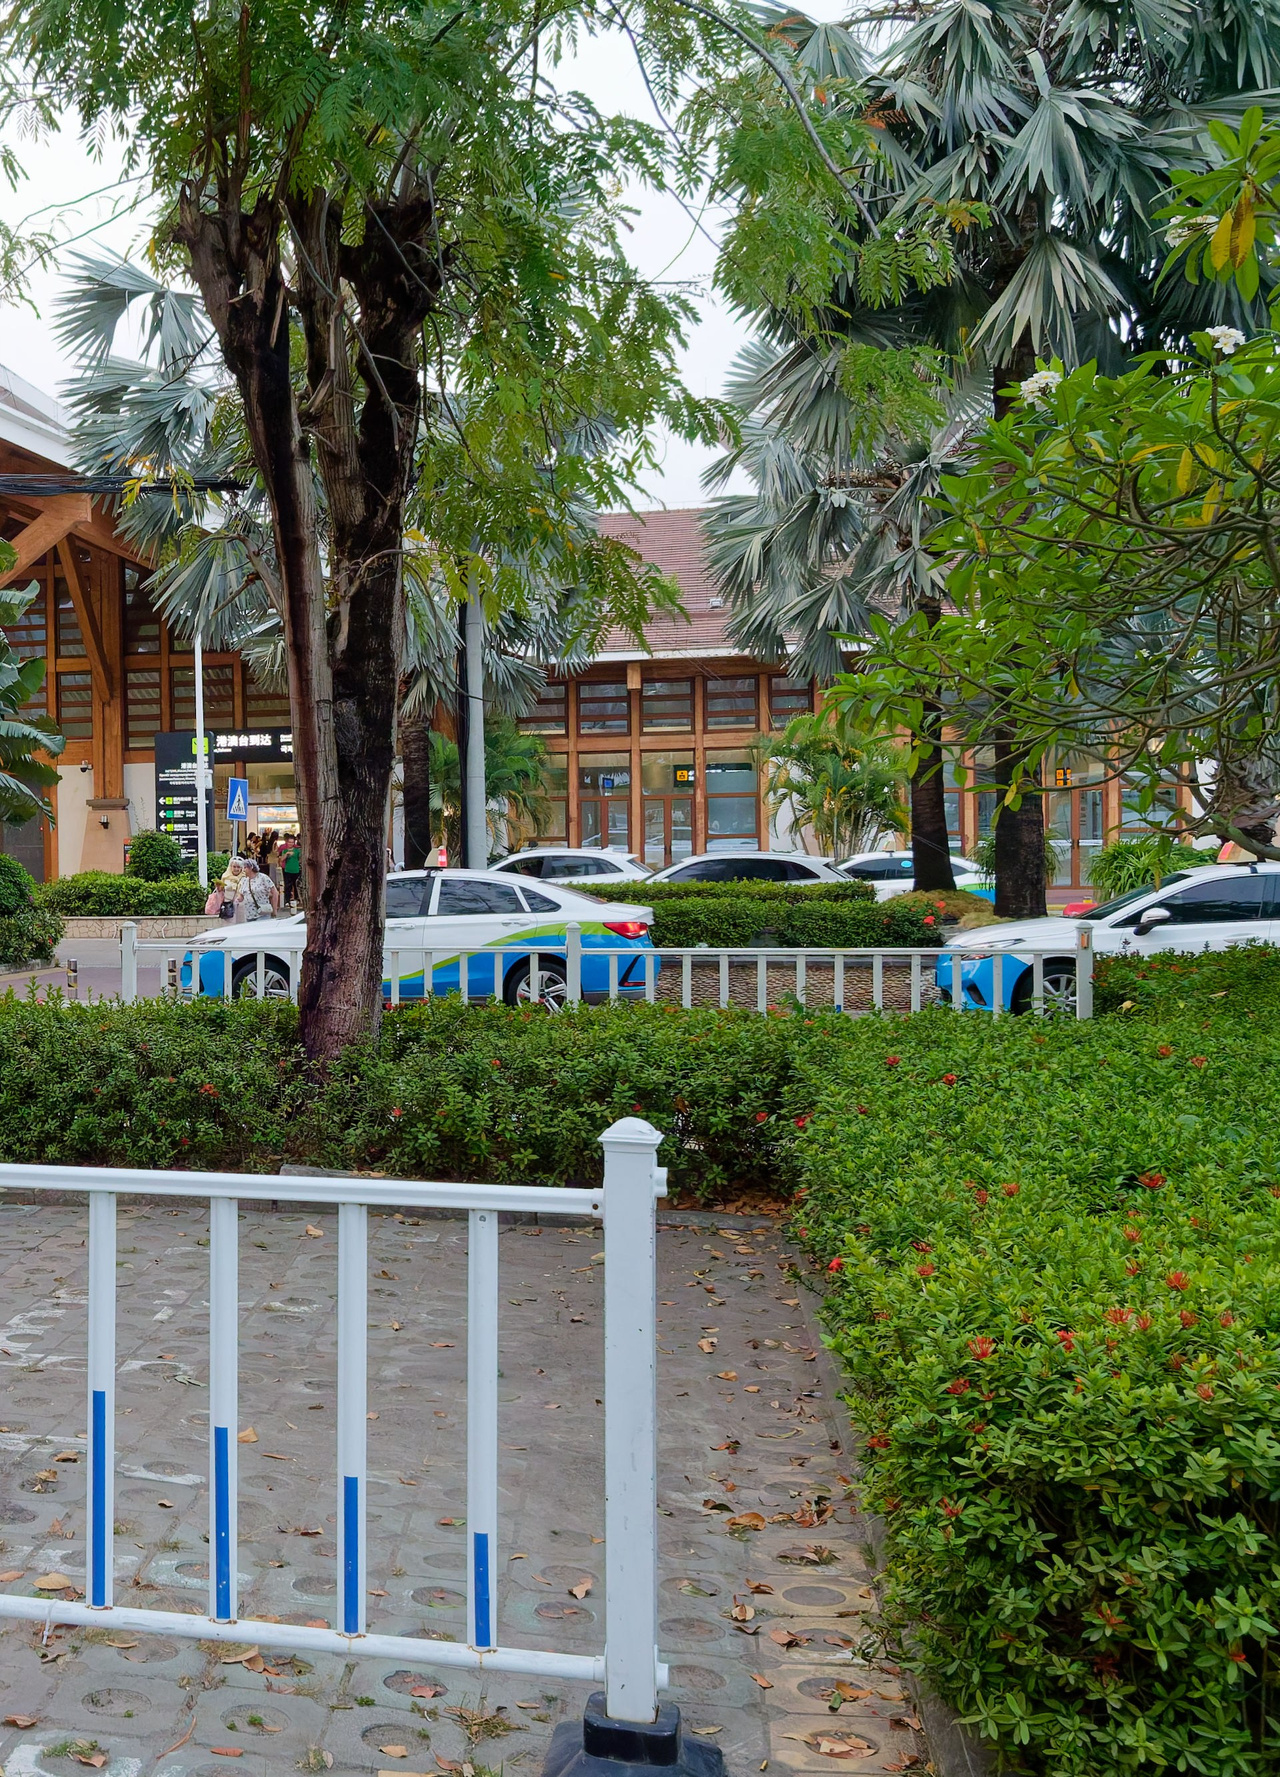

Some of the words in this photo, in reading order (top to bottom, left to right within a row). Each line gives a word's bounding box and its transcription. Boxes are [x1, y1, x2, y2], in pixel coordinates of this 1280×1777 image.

[216, 734, 272, 747] 港澳台到达
